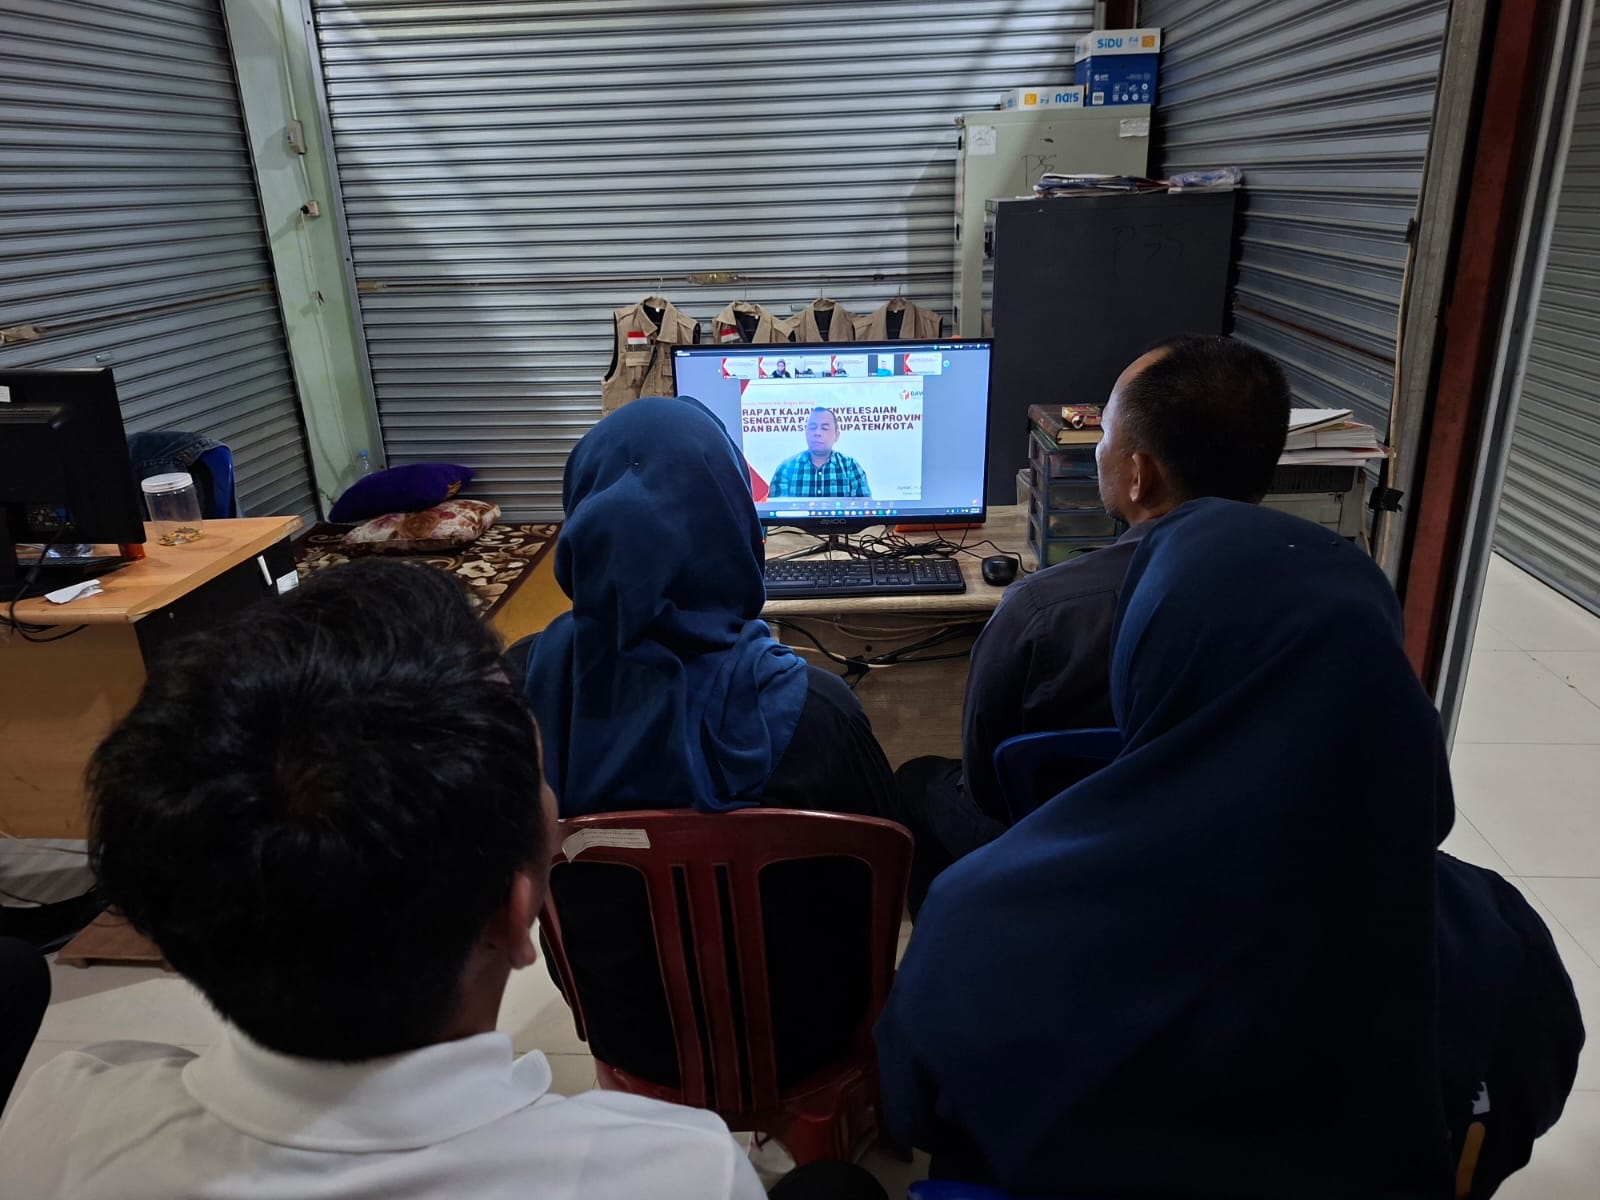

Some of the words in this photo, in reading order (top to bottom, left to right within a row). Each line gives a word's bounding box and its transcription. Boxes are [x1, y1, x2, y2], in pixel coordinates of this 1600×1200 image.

[742, 408, 777, 416] RAPAT
[829, 406, 898, 415] NYELESAIAN
[742, 416, 797, 425] SENGKETA
[836, 414, 880, 423] AWASLU
[882, 413, 921, 422] PROVIN
[743, 425, 764, 433] DAN
[766, 424, 808, 433] BAWAS
[839, 422, 914, 431] UPATEN/KOTA
